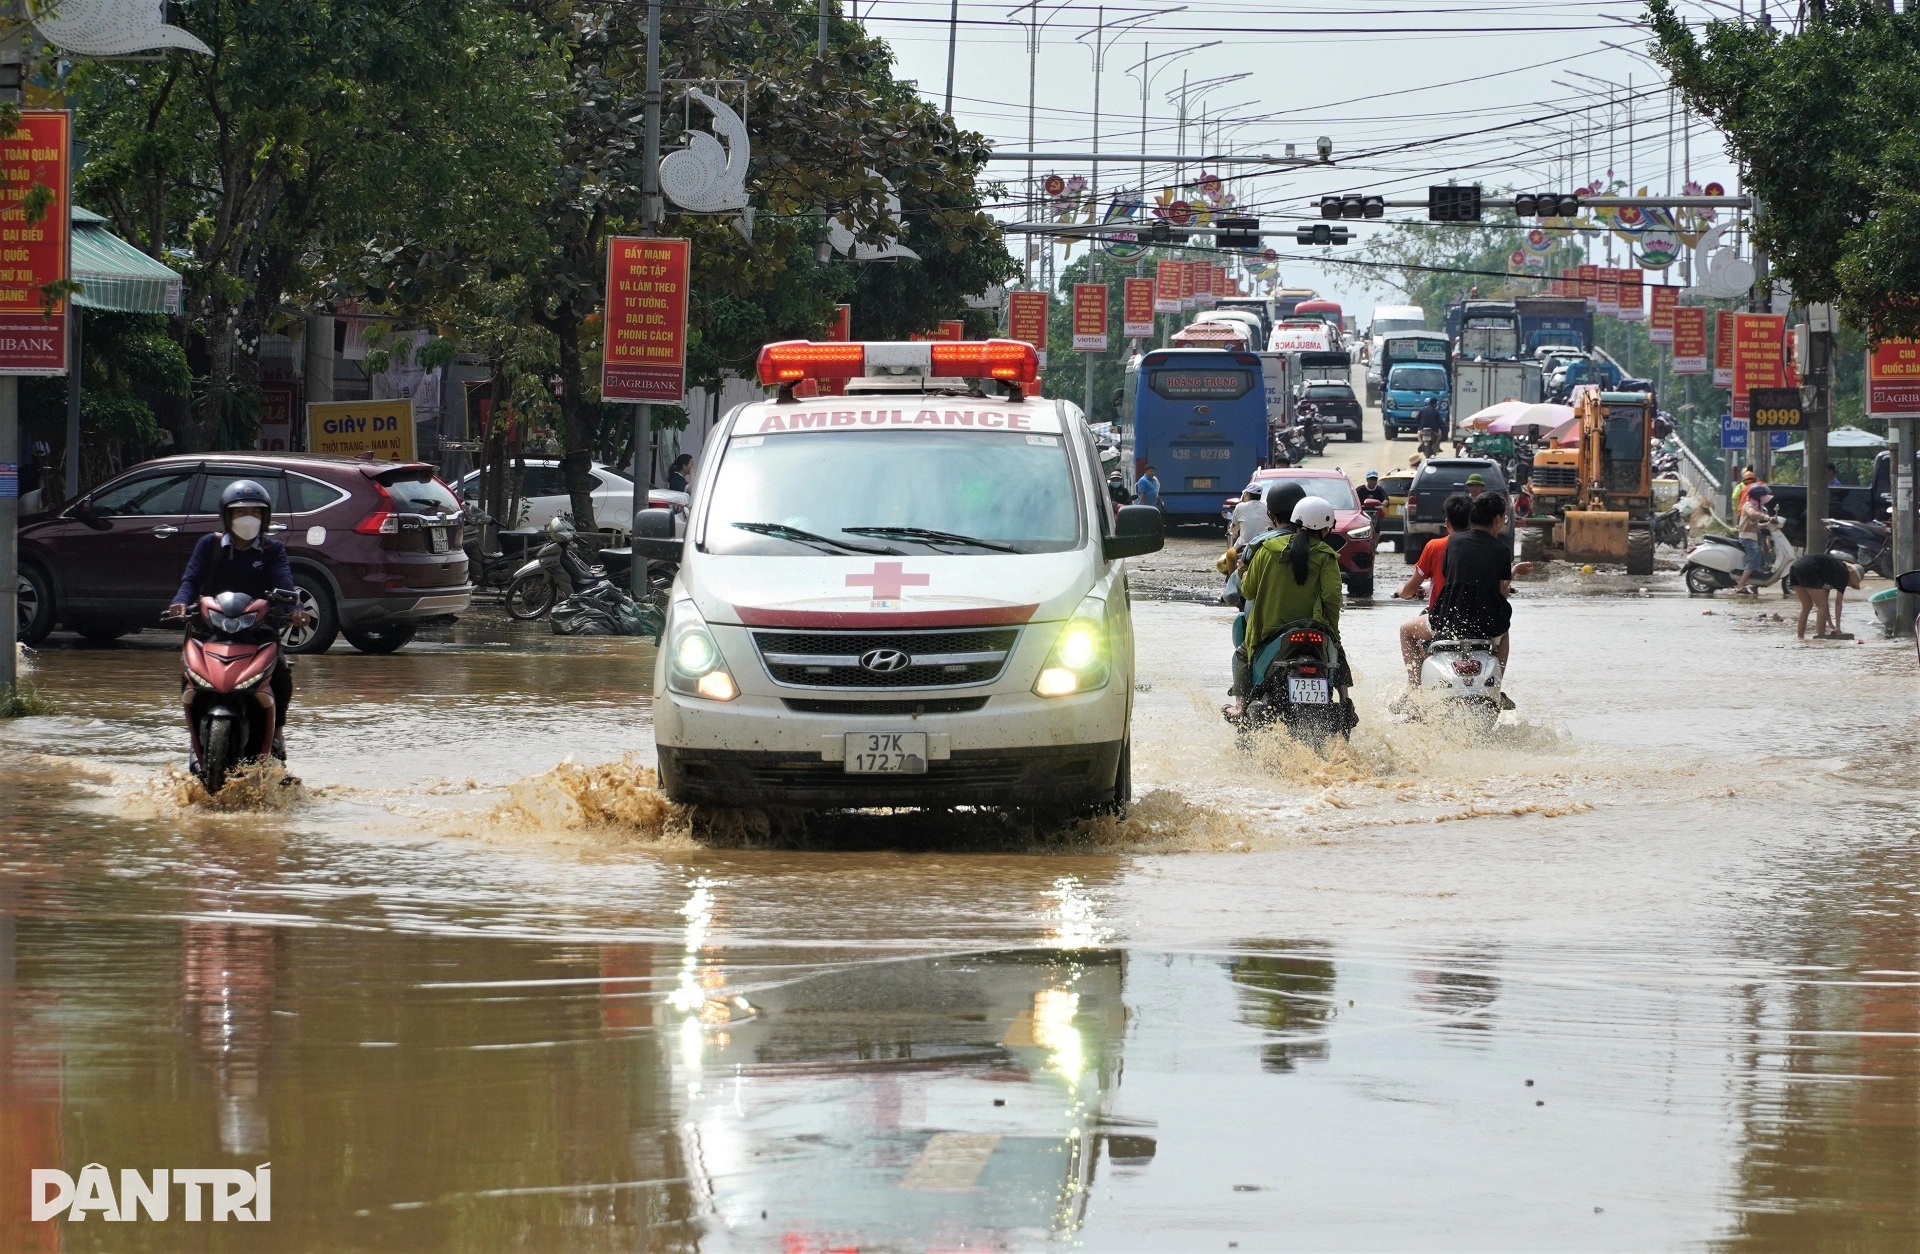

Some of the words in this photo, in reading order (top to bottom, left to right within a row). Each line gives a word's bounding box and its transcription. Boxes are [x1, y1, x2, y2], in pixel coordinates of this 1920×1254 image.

[4, 146, 29, 160] TOÀN
[31, 146, 58, 162] QUÂN
[10, 164, 30, 180] ĐẤU
[3, 229, 19, 243] ĐẠI
[21, 224, 43, 241] BIỂU
[4, 245, 30, 262] QUỐC
[624, 245, 643, 259] ĐẨY
[644, 250, 671, 262] MẠNH
[17, 269, 33, 281] XIII
[630, 265, 648, 277] HỌC
[650, 264, 667, 278] TẬP
[619, 279, 631, 291] VÀ
[633, 280, 652, 292] LÀM
[654, 282, 676, 293] THEO
[625, 297, 636, 307] TƯ
[626, 313, 644, 326] ĐẠO
[645, 312, 666, 325] ĐỨC,
[1744, 320, 1759, 328] CHÀO
[617, 329, 647, 340] PHONG
[650, 327, 674, 341] CÁCH
[615, 343, 627, 355] HỒ
[629, 344, 645, 356] CHÍ
[647, 346, 674, 358] MINH!
[1899, 349, 1916, 359] CHO
[1882, 362, 1904, 374] QUỐC
[618, 379, 676, 390] AGRIBANK
[1204, 376, 1237, 388] TRUNG
[1886, 393, 1920, 403] AGRIB
[758, 410, 1031, 433] AMBULANCE
[1756, 408, 1800, 426] 9999
[323, 415, 366, 434] GIÀY
[373, 416, 398, 432] DA
[340, 441, 364, 452] TRANG
[371, 440, 389, 450] NAM
[390, 437, 401, 449] NỮ
[1172, 449, 1190, 460] 43B
[1294, 679, 1321, 691] 73-E1
[868, 734, 903, 752] 37K
